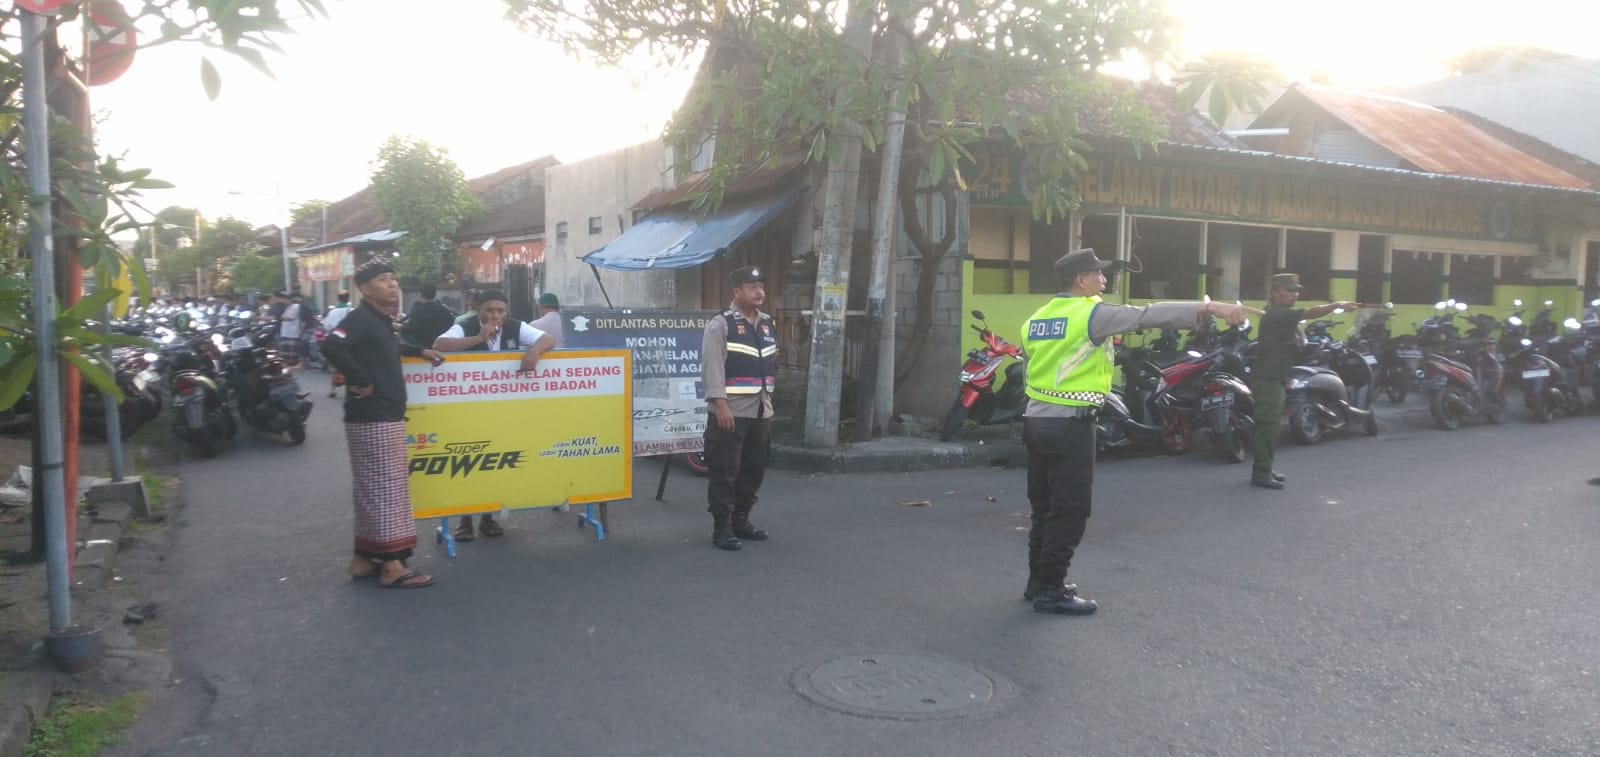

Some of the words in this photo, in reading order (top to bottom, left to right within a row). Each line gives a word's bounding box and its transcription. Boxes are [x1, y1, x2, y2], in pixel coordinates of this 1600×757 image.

[969, 155, 1009, 193] 24
[1170, 166, 1241, 217] DATANG
[595, 318, 657, 329] DITLANTAS
[659, 318, 696, 329] POLDA
[1029, 320, 1066, 338] POLISI
[625, 337, 678, 348] MOHON
[404, 371, 457, 384] MOHON
[462, 367, 561, 381] PELAN-PELAN
[566, 365, 621, 378] SEDANG
[427, 381, 540, 396] BERLANGSUNG
[545, 379, 597, 392] IBADAH
[405, 432, 438, 444] ABC
[571, 436, 598, 447] KUAT,
[438, 439, 491, 454] Super
[557, 447, 590, 459] TAHAN
[592, 446, 621, 457] LAMA
[407, 449, 524, 478] POWER
